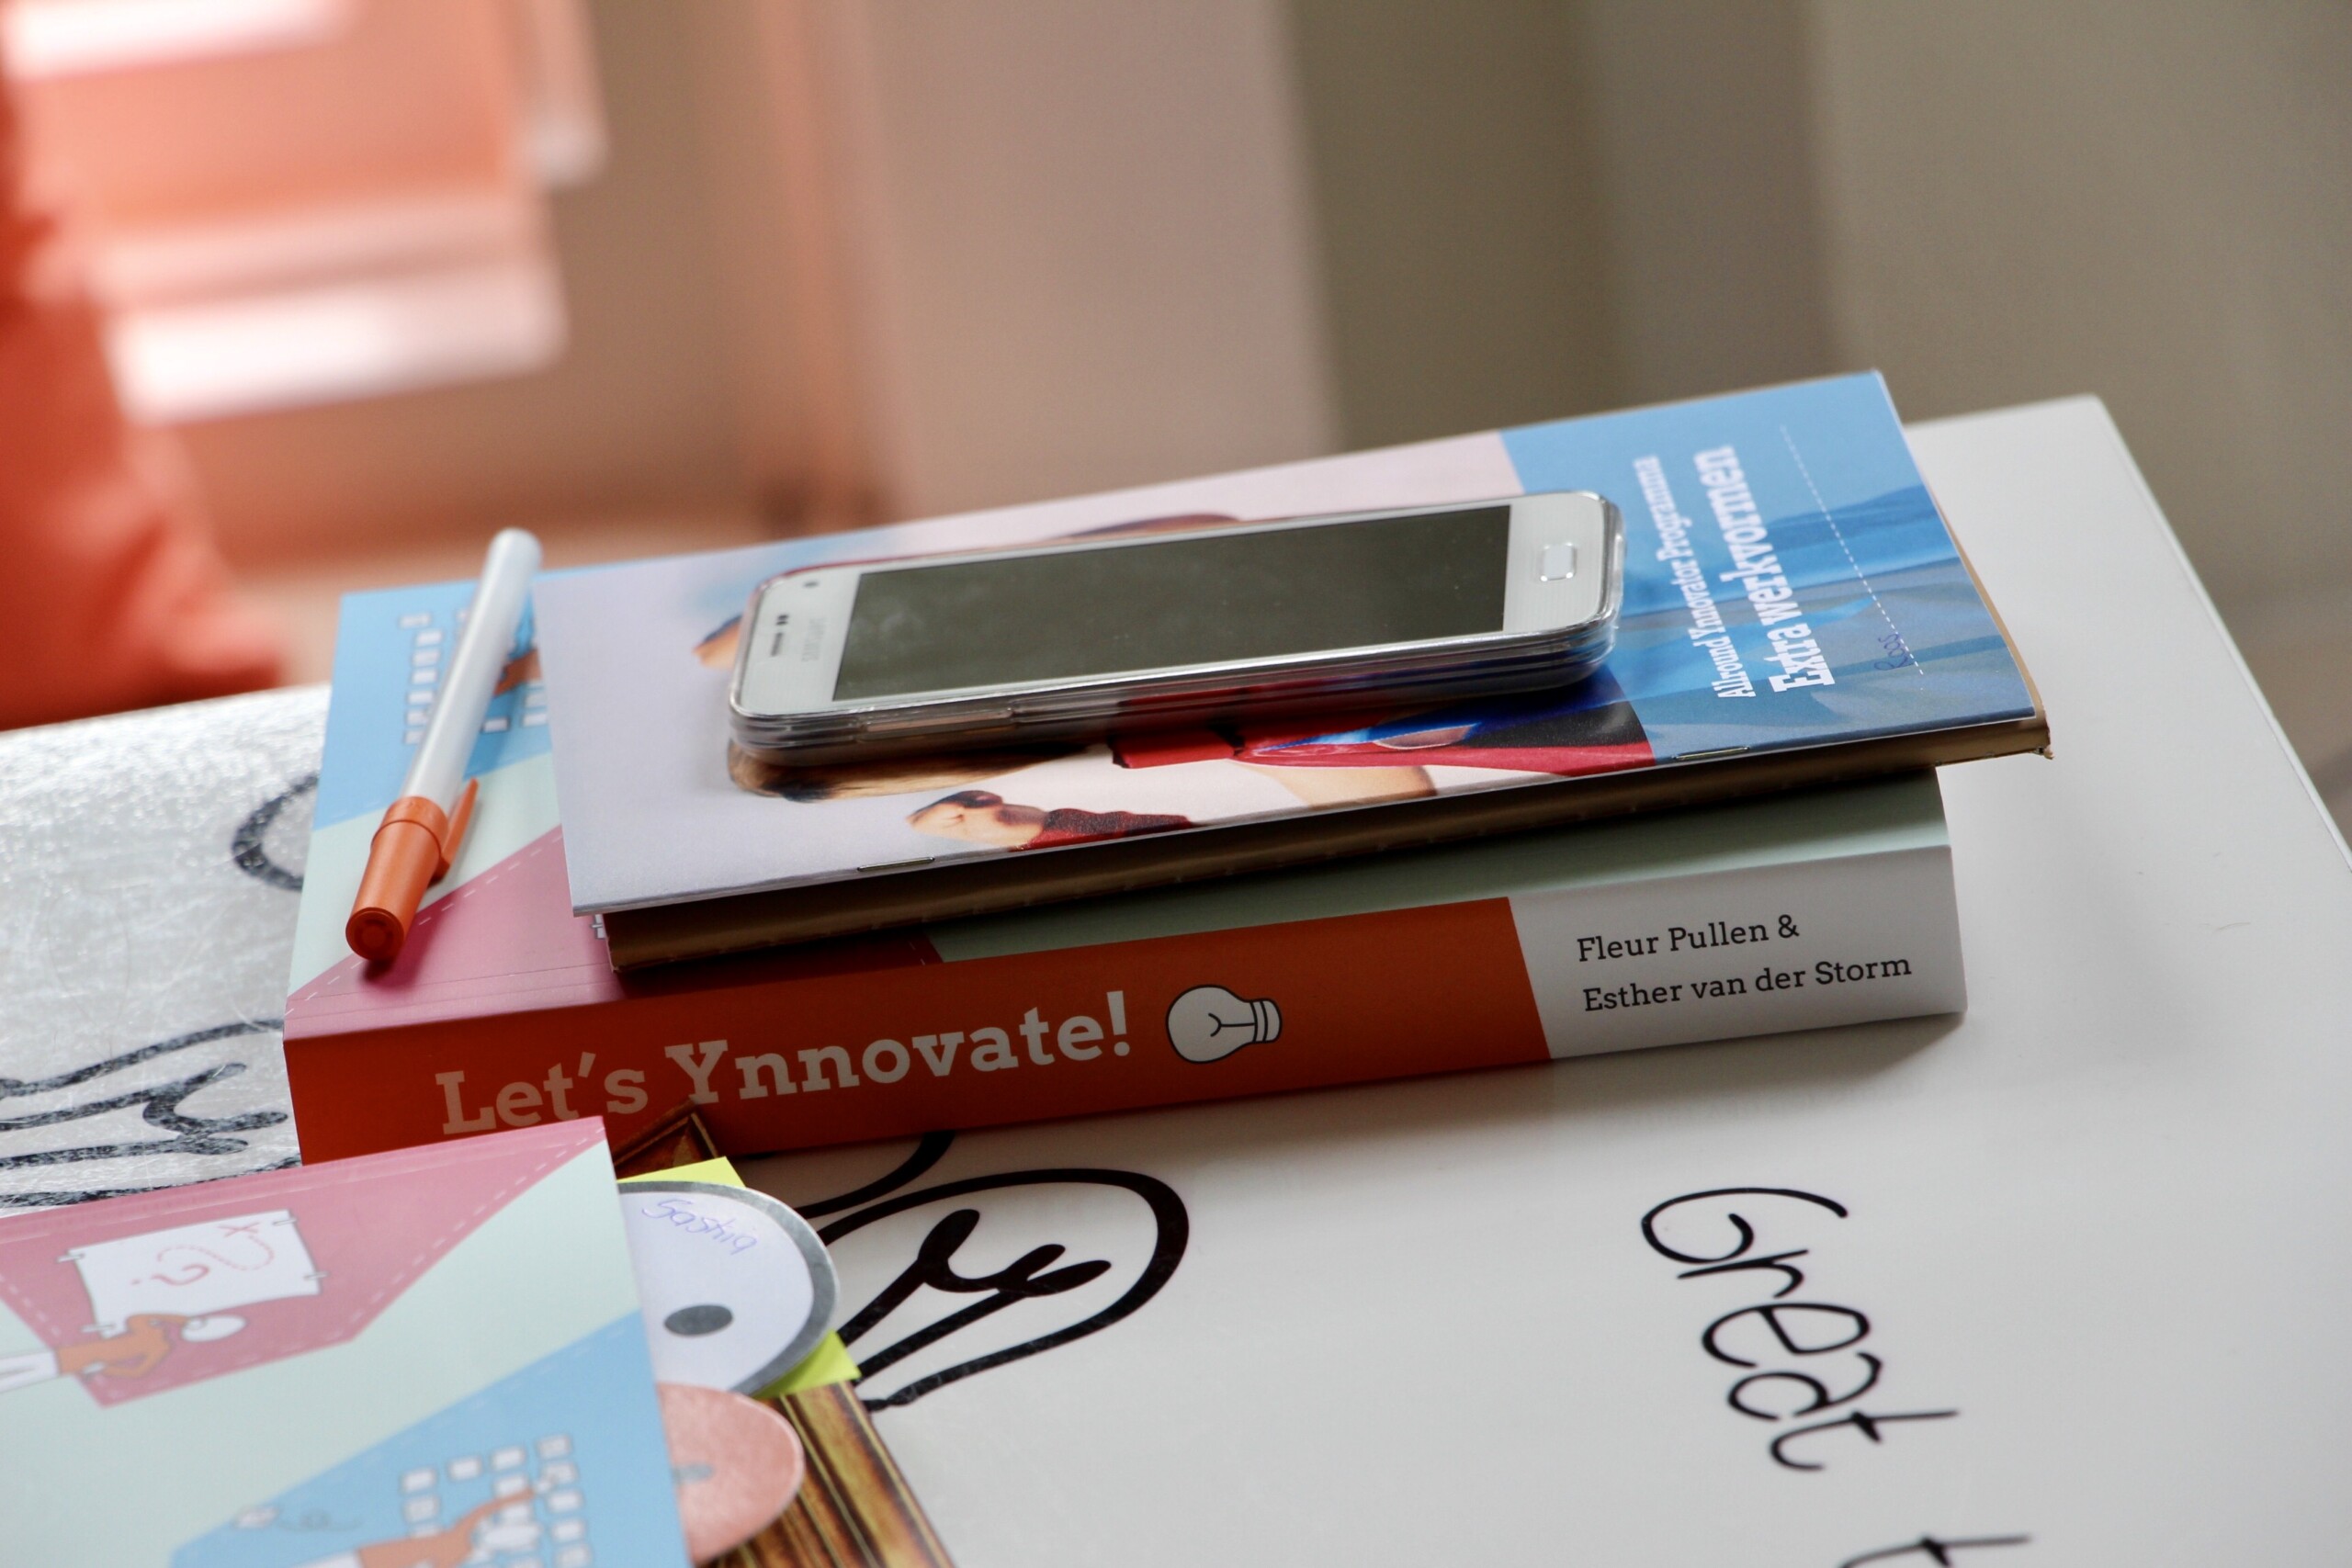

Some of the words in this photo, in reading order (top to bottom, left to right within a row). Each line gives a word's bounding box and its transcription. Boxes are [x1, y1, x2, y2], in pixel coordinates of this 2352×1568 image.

[1634, 456, 1693, 561] Programma
[1694, 446, 1803, 626] werkvormen
[1671, 558, 1725, 647] Ynnovator
[1705, 636, 1756, 697] Allround
[1764, 622, 1836, 693] Extra
[1577, 933, 1659, 963] Fleur
[1668, 921, 1770, 953] Pullen
[1777, 913, 1800, 939] &
[1583, 982, 1683, 1011] Esther
[1690, 976, 1747, 999] van
[1755, 967, 1806, 992] der
[1815, 958, 1912, 986] Storm
[435, 1051, 649, 1135] Let's
[664, 990, 1131, 1104] Ynnovate!
[1641, 1187, 1962, 1472] Great
